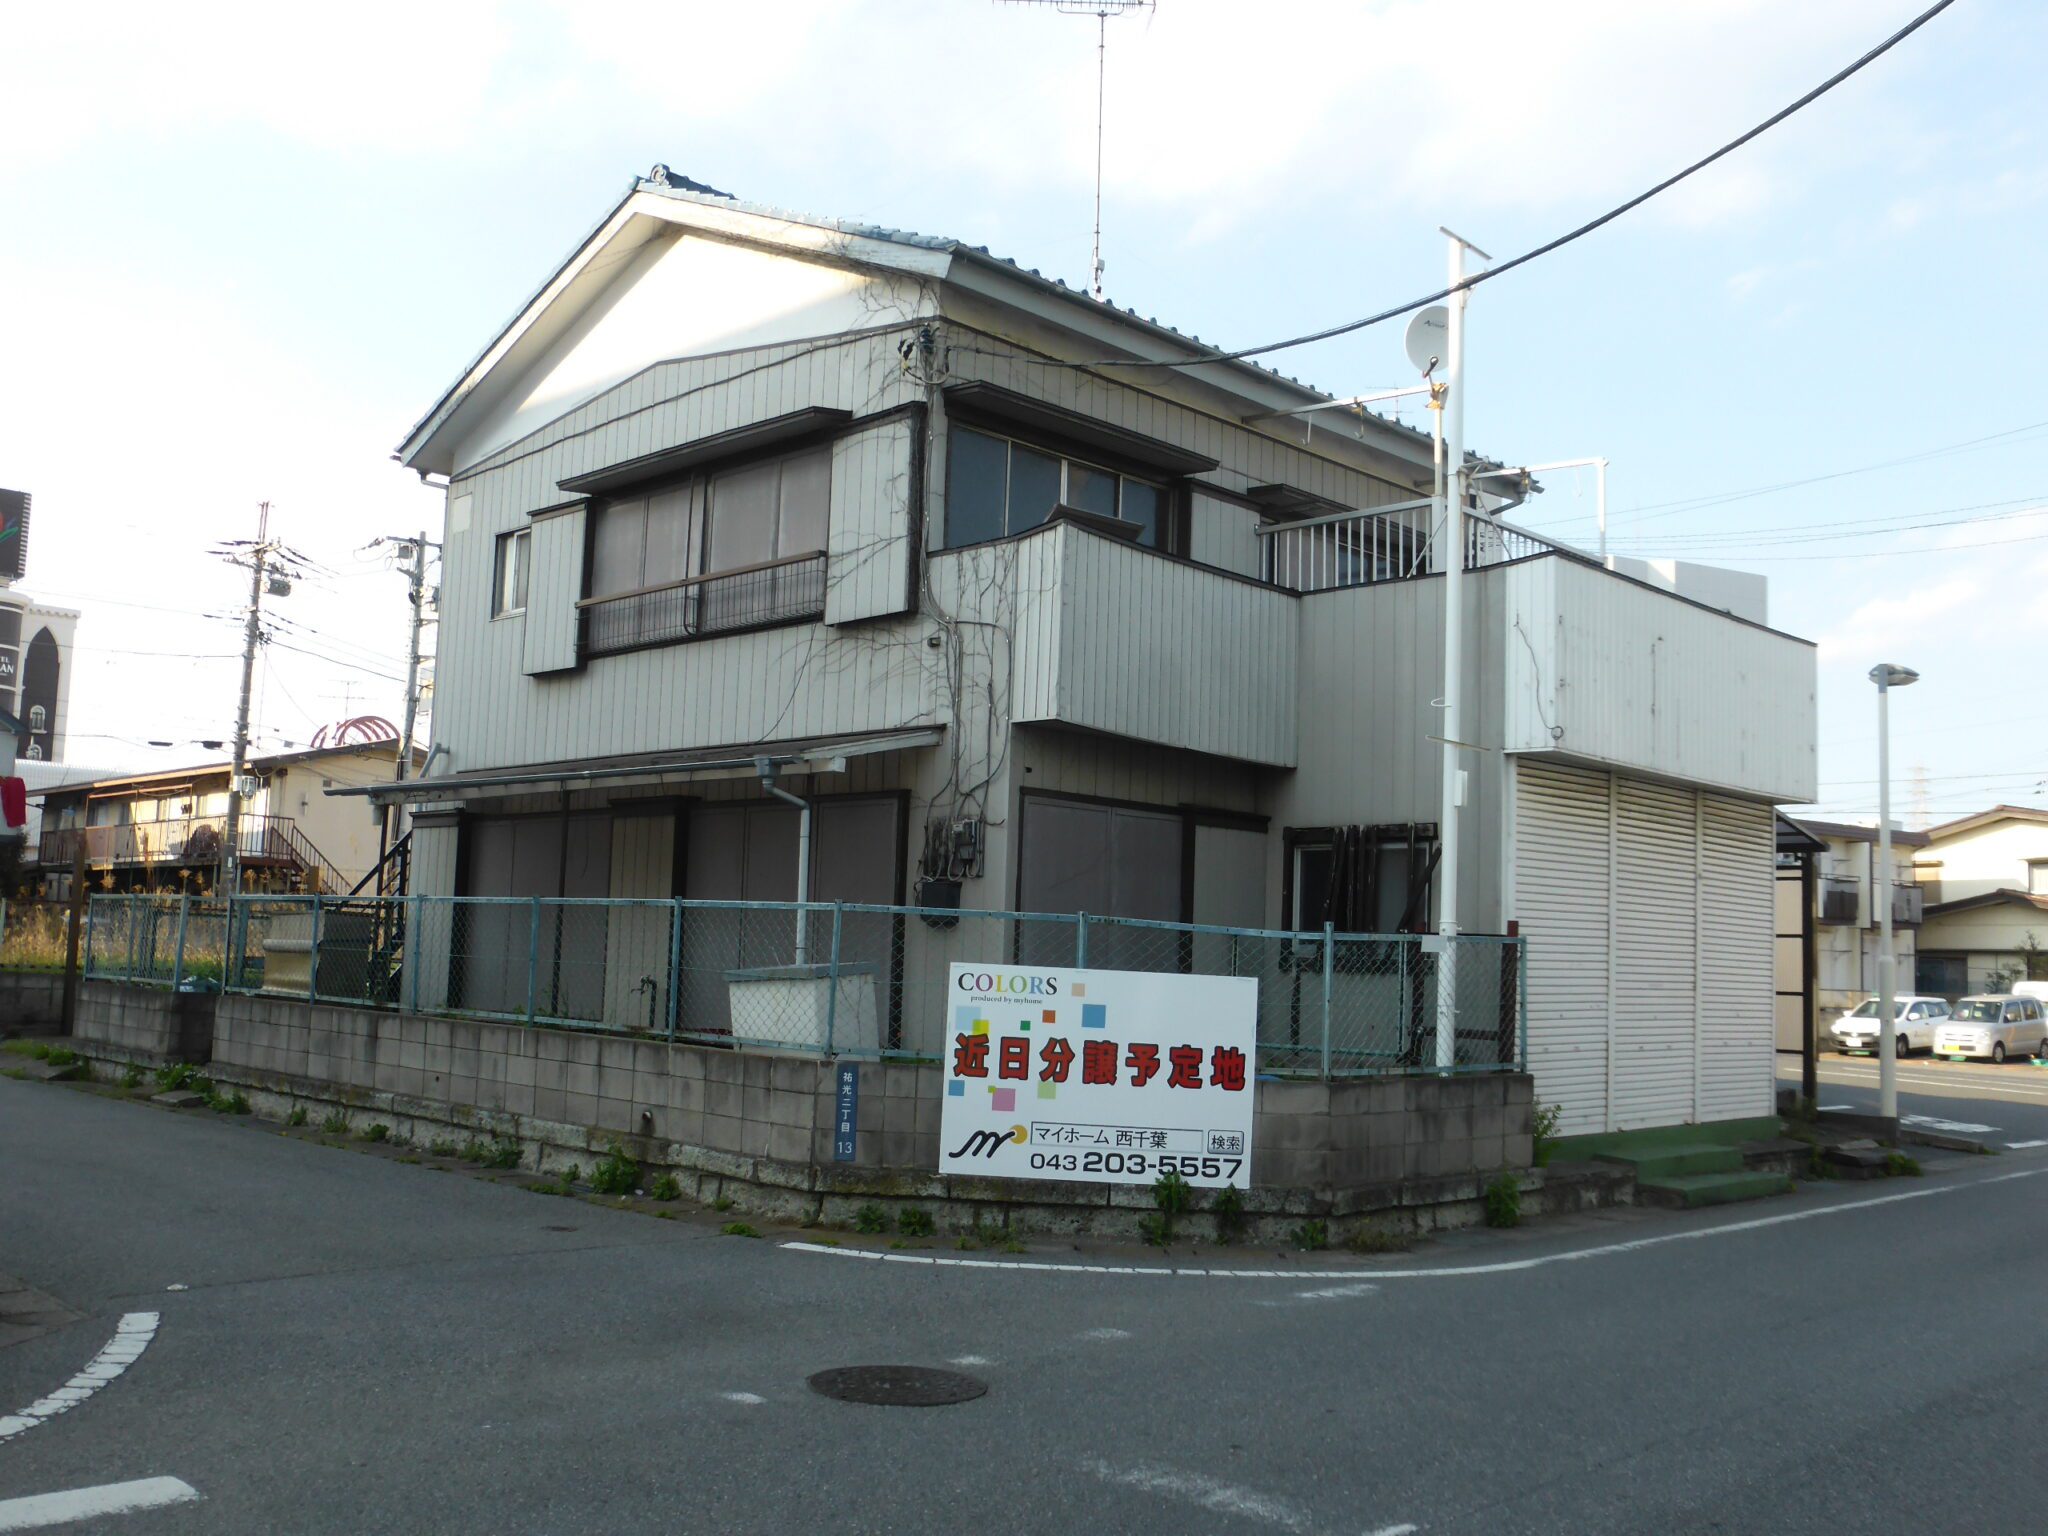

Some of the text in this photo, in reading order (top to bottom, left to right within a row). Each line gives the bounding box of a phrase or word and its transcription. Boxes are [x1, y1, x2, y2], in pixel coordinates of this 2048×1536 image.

[958, 973, 1058, 996] COLORS
[970, 995, 1043, 1006] produced by myhome
[953, 1033, 1247, 1092] 近日分譲予定地
[841, 1072, 854, 1133] 祐光二丁目
[837, 1142, 852, 1154] 13
[1035, 1126, 1168, 1150] マイホーム 西千葉
[1211, 1134, 1241, 1151] 検索
[1030, 1152, 1243, 1179] 043 203-5557
